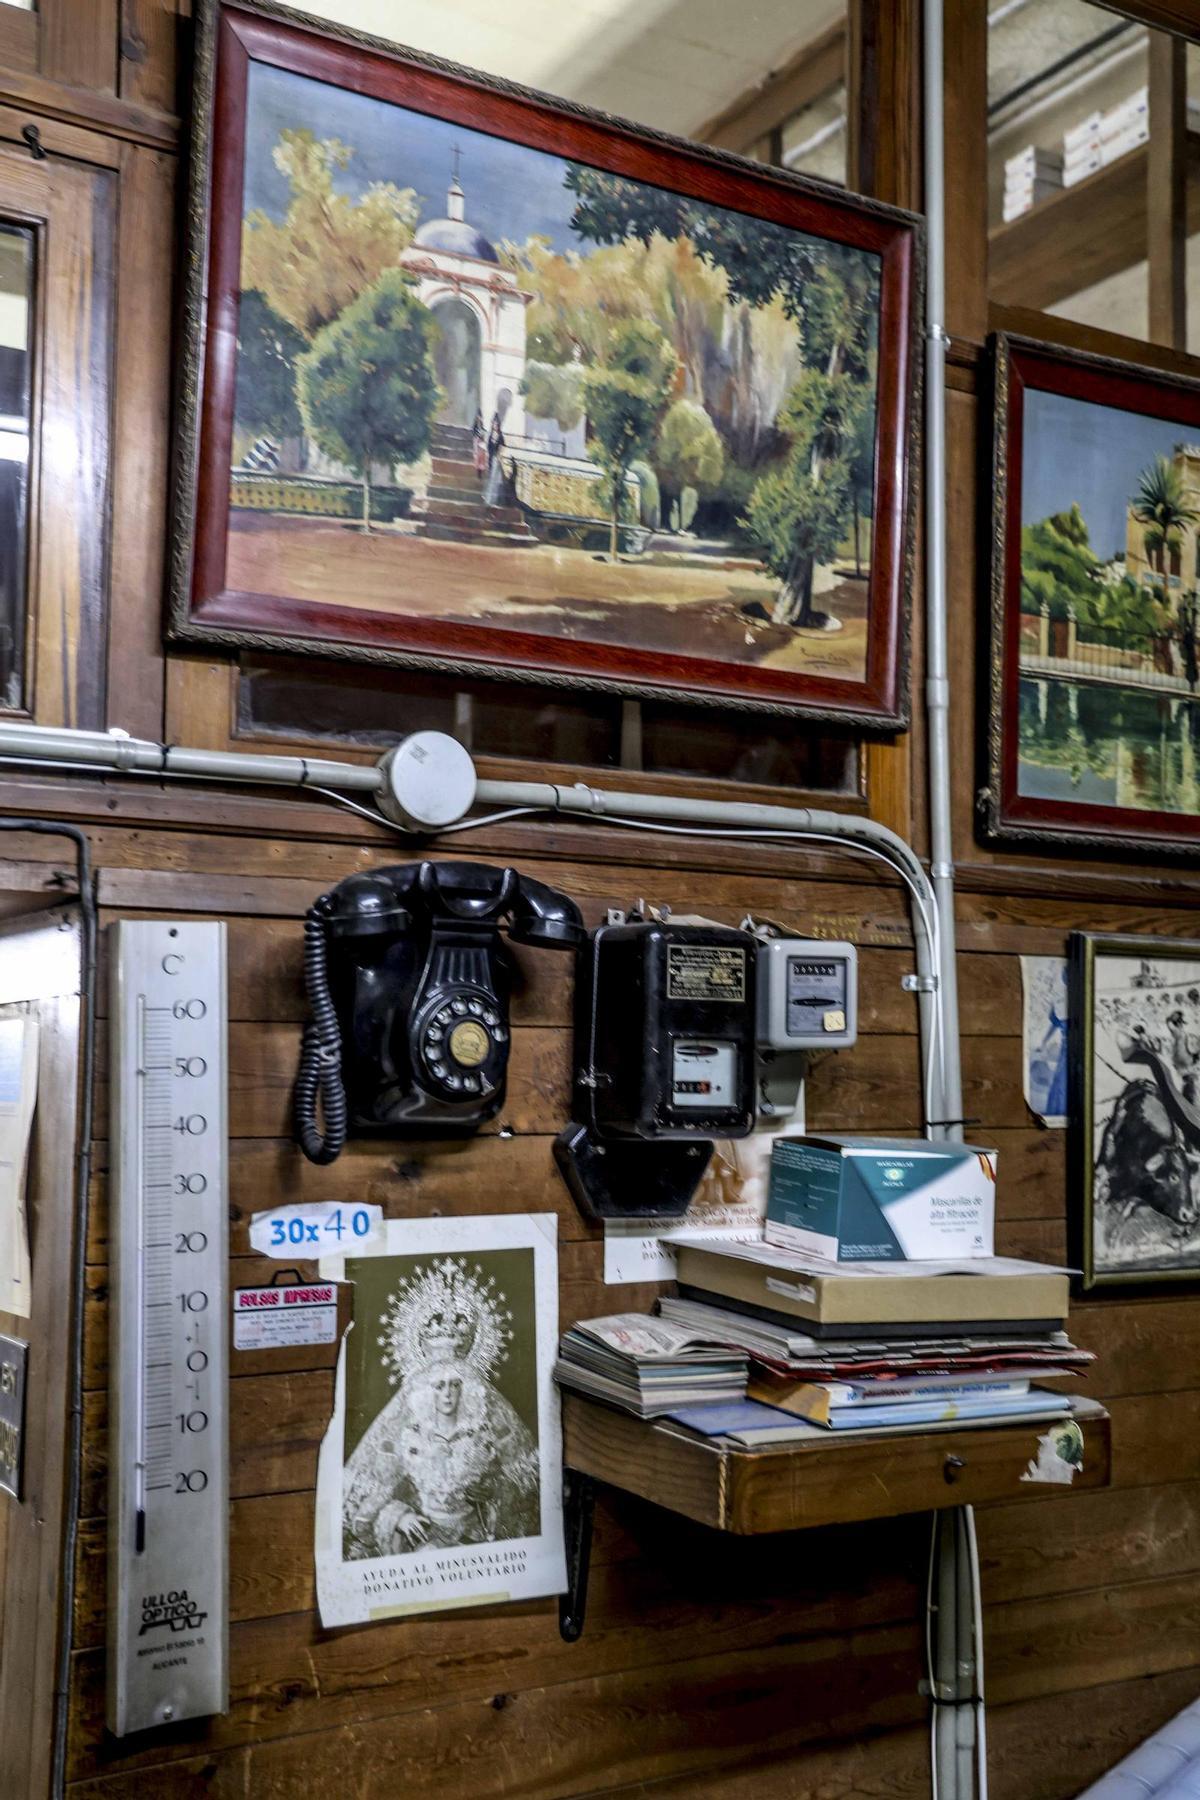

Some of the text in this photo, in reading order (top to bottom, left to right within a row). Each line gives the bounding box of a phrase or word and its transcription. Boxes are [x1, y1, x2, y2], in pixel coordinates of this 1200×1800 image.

[172, 998, 207, 1021] 60
[174, 1056, 207, 1079] 50
[173, 1113, 207, 1136] 40
[174, 1172, 207, 1195] 30
[175, 1231, 208, 1254] 20
[178, 1290, 208, 1313] 10
[186, 1350, 208, 1373] 0
[176, 1410, 208, 1433] 10
[175, 1469, 208, 1493] 20
[362, 1568, 405, 1583] AYUDA
[414, 1563, 427, 1575] AL
[363, 1563, 527, 1595] DONATIVO VOLUNTARIO
[142, 1590, 188, 1609] ULLOA
[142, 1601, 197, 1622] OPTICO
